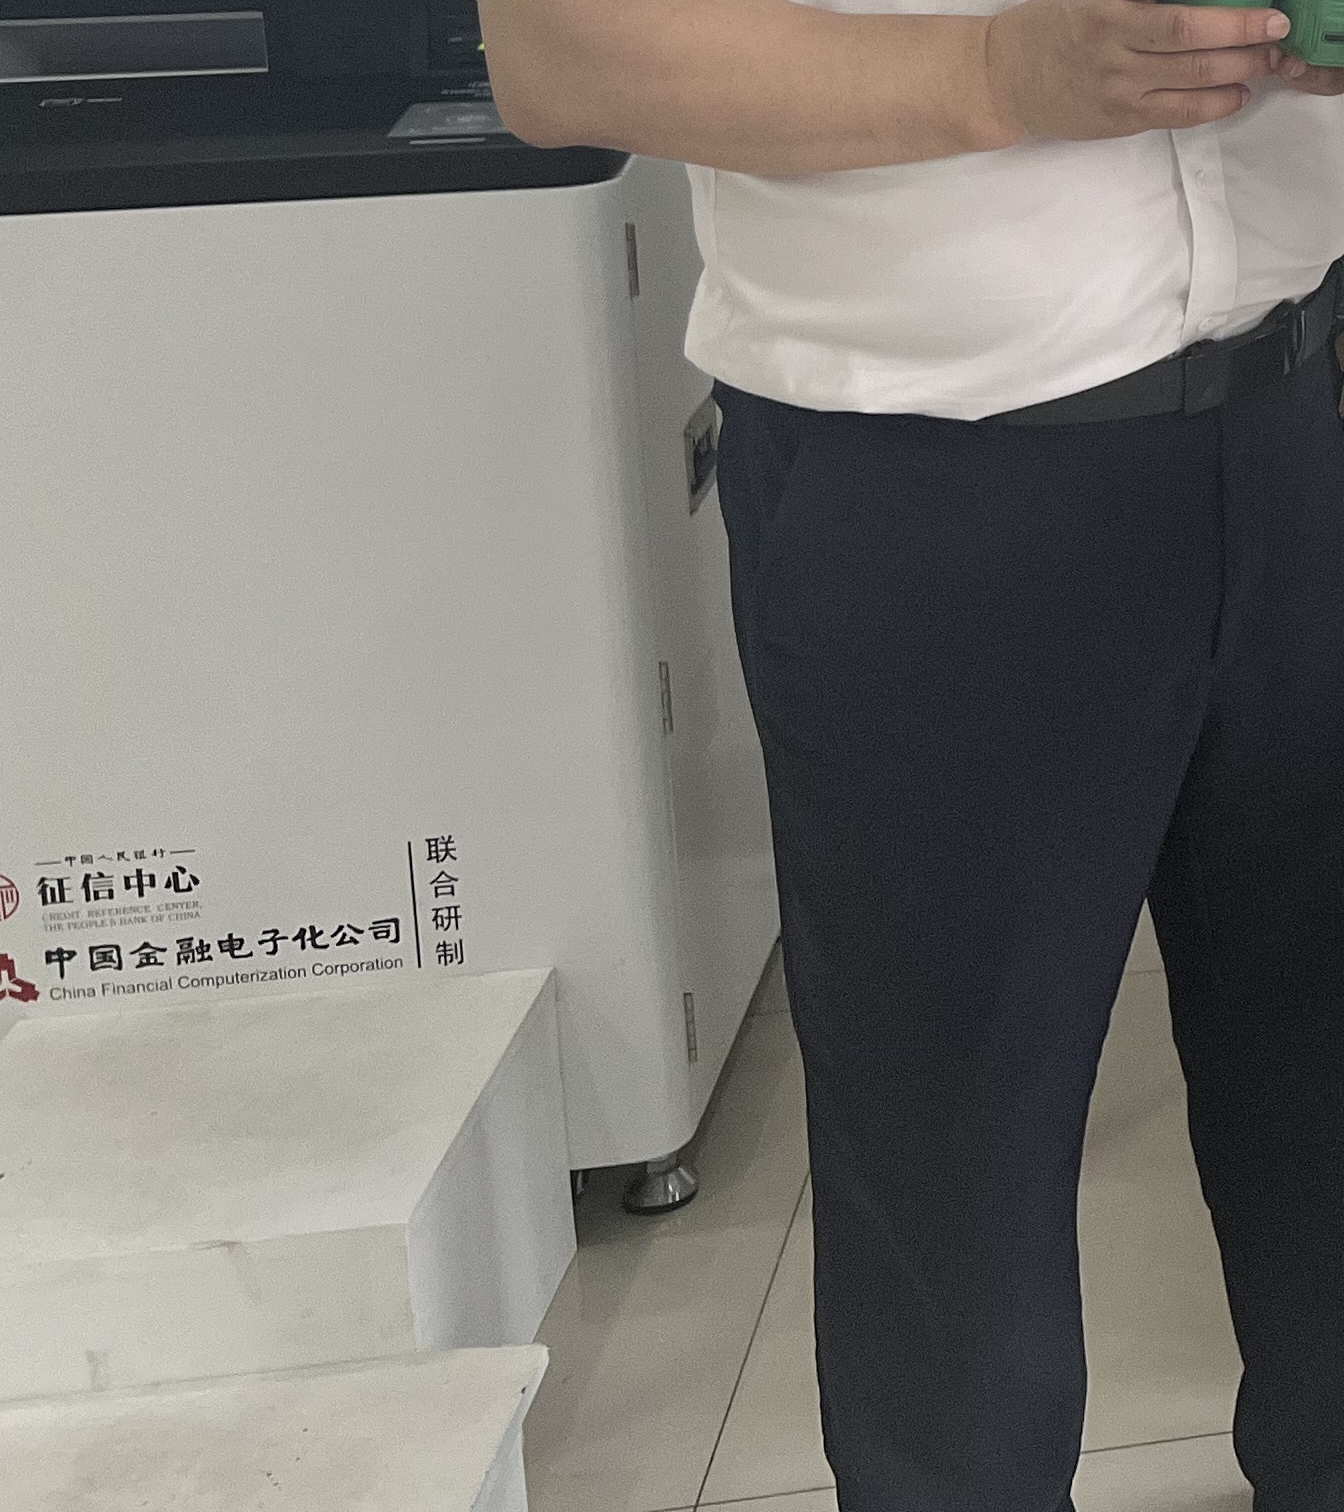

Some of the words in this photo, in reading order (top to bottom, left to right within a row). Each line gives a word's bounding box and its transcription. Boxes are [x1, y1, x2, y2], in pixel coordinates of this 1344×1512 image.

[37, 865, 200, 907] 征信中心
[426, 835, 465, 966] 联合研制
[168, 911, 202, 922] CHINA
[45, 917, 401, 979] 中国金融电子化公司
[49, 985, 97, 1002] China
[101, 977, 173, 997] Financial
[178, 964, 307, 992] Computerization
[311, 955, 403, 979] Corporation
